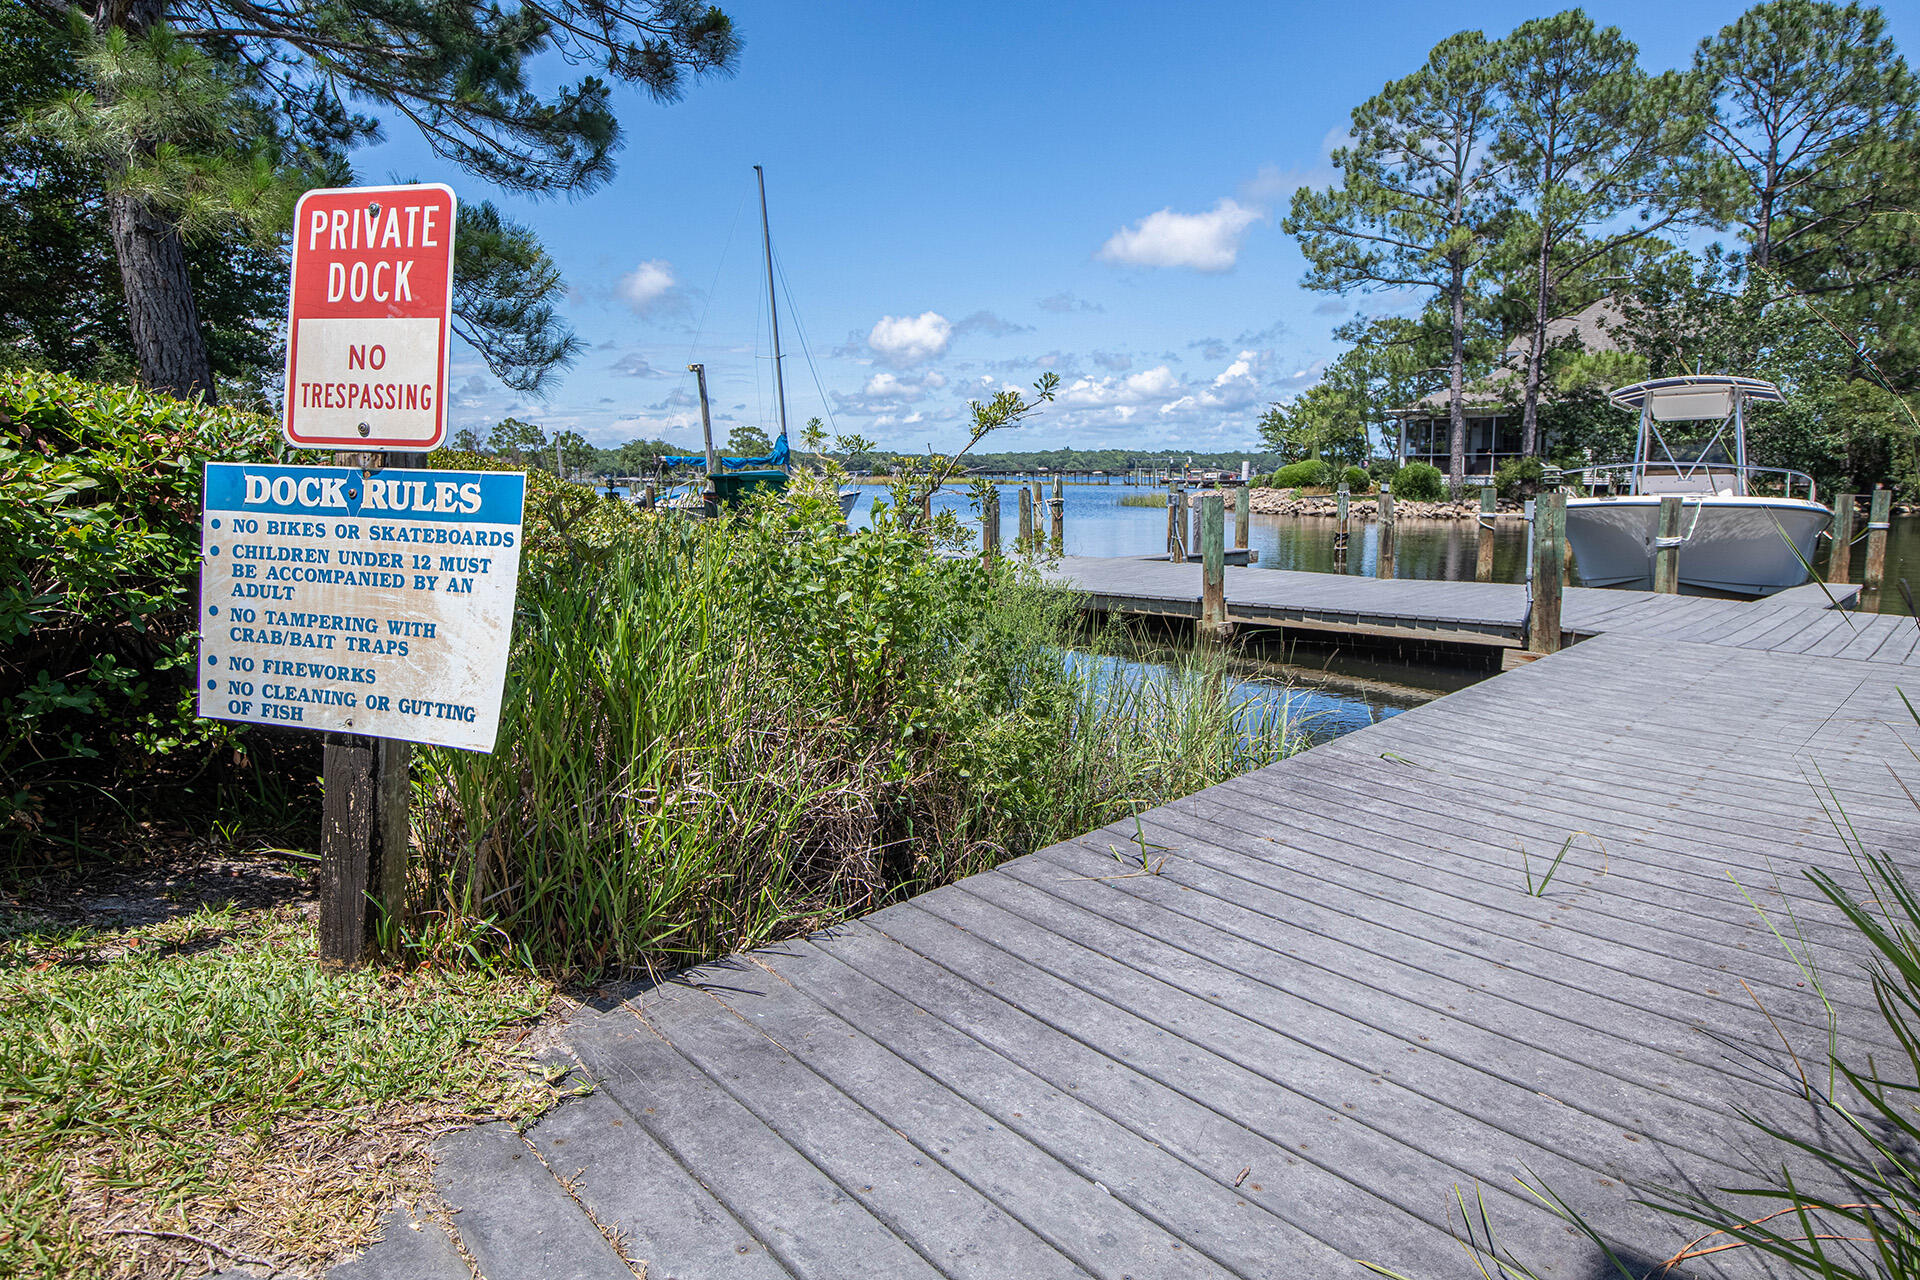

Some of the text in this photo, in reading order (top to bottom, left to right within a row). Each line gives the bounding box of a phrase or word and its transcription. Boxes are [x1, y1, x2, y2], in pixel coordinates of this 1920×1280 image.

[309, 205, 440, 251] PRIVATE
[327, 260, 414, 303] DOCK
[348, 344, 386, 371] NO
[301, 382, 432, 410] TRESPASSING
[244, 474, 483, 514] DOCK RULES
[232, 518, 515, 548] NO BIKES OR SKATEBOARDS
[232, 544, 492, 574] CHILDREN UNDER 12 MUST
[231, 563, 474, 593] BE ACCOMPANIED BY AN
[231, 582, 296, 601] ADULT
[230, 607, 437, 639] NO TAMPERING WITH
[229, 627, 409, 657] CRAB/BAIT TRAPS
[228, 656, 376, 684] NO FIREWORKS
[228, 680, 476, 723] NO CLEANING OR GUTTING
[228, 700, 304, 722] OF FISH
